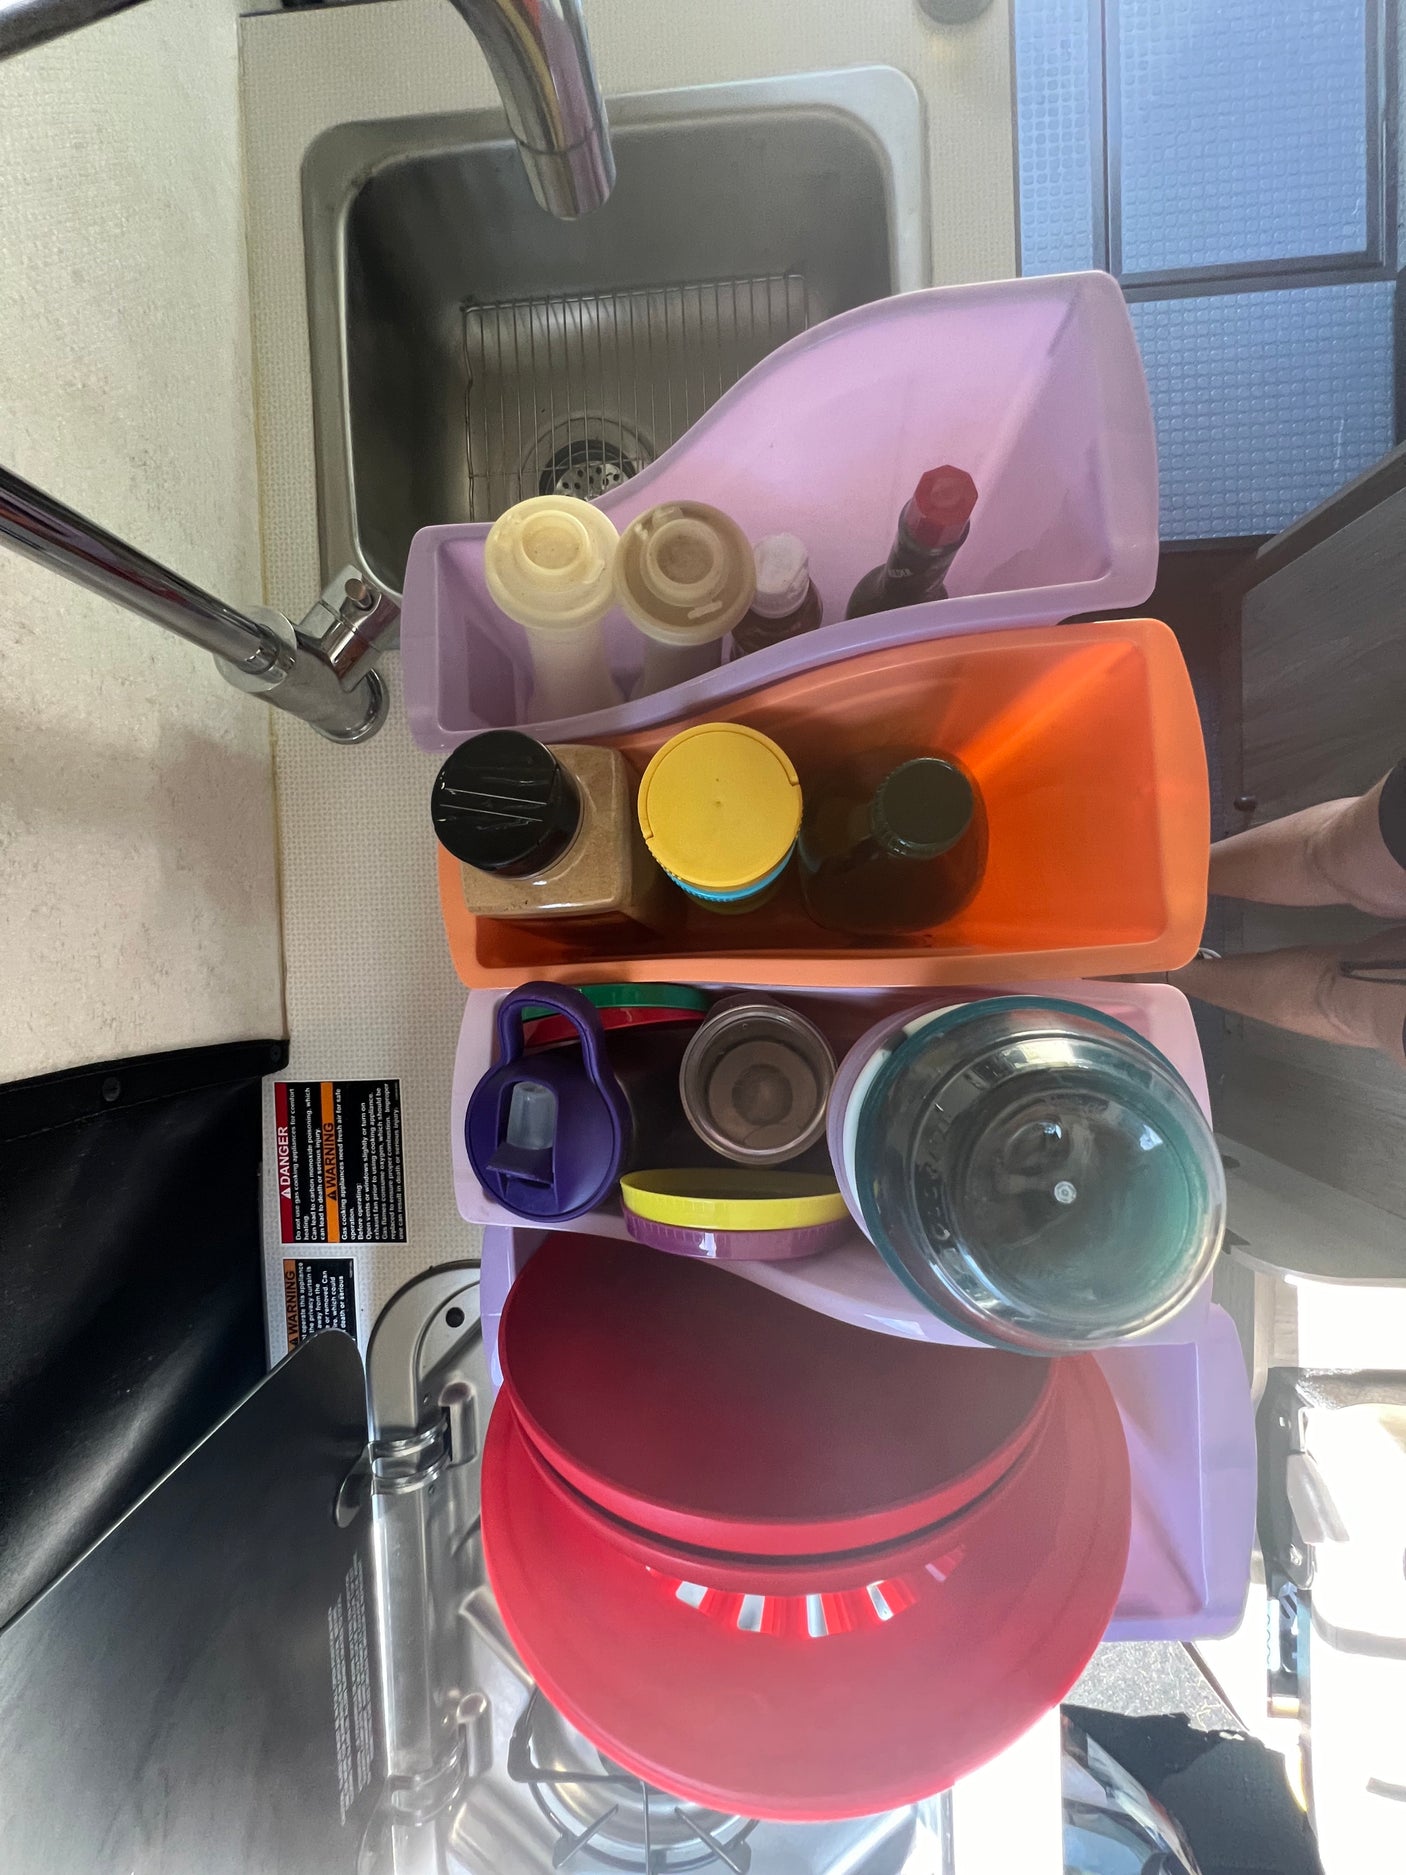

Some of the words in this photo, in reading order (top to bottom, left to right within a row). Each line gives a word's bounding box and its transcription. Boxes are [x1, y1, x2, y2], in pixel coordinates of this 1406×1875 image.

[376, 1088, 381, 1096] be
[361, 1103, 365, 1111] on
[278, 1127, 290, 1185] DANGER
[324, 1123, 336, 1188] WARNING
[361, 1137, 369, 1161] slightly
[296, 1231, 301, 1240] Do
[286, 1271, 297, 1334] WARNING
